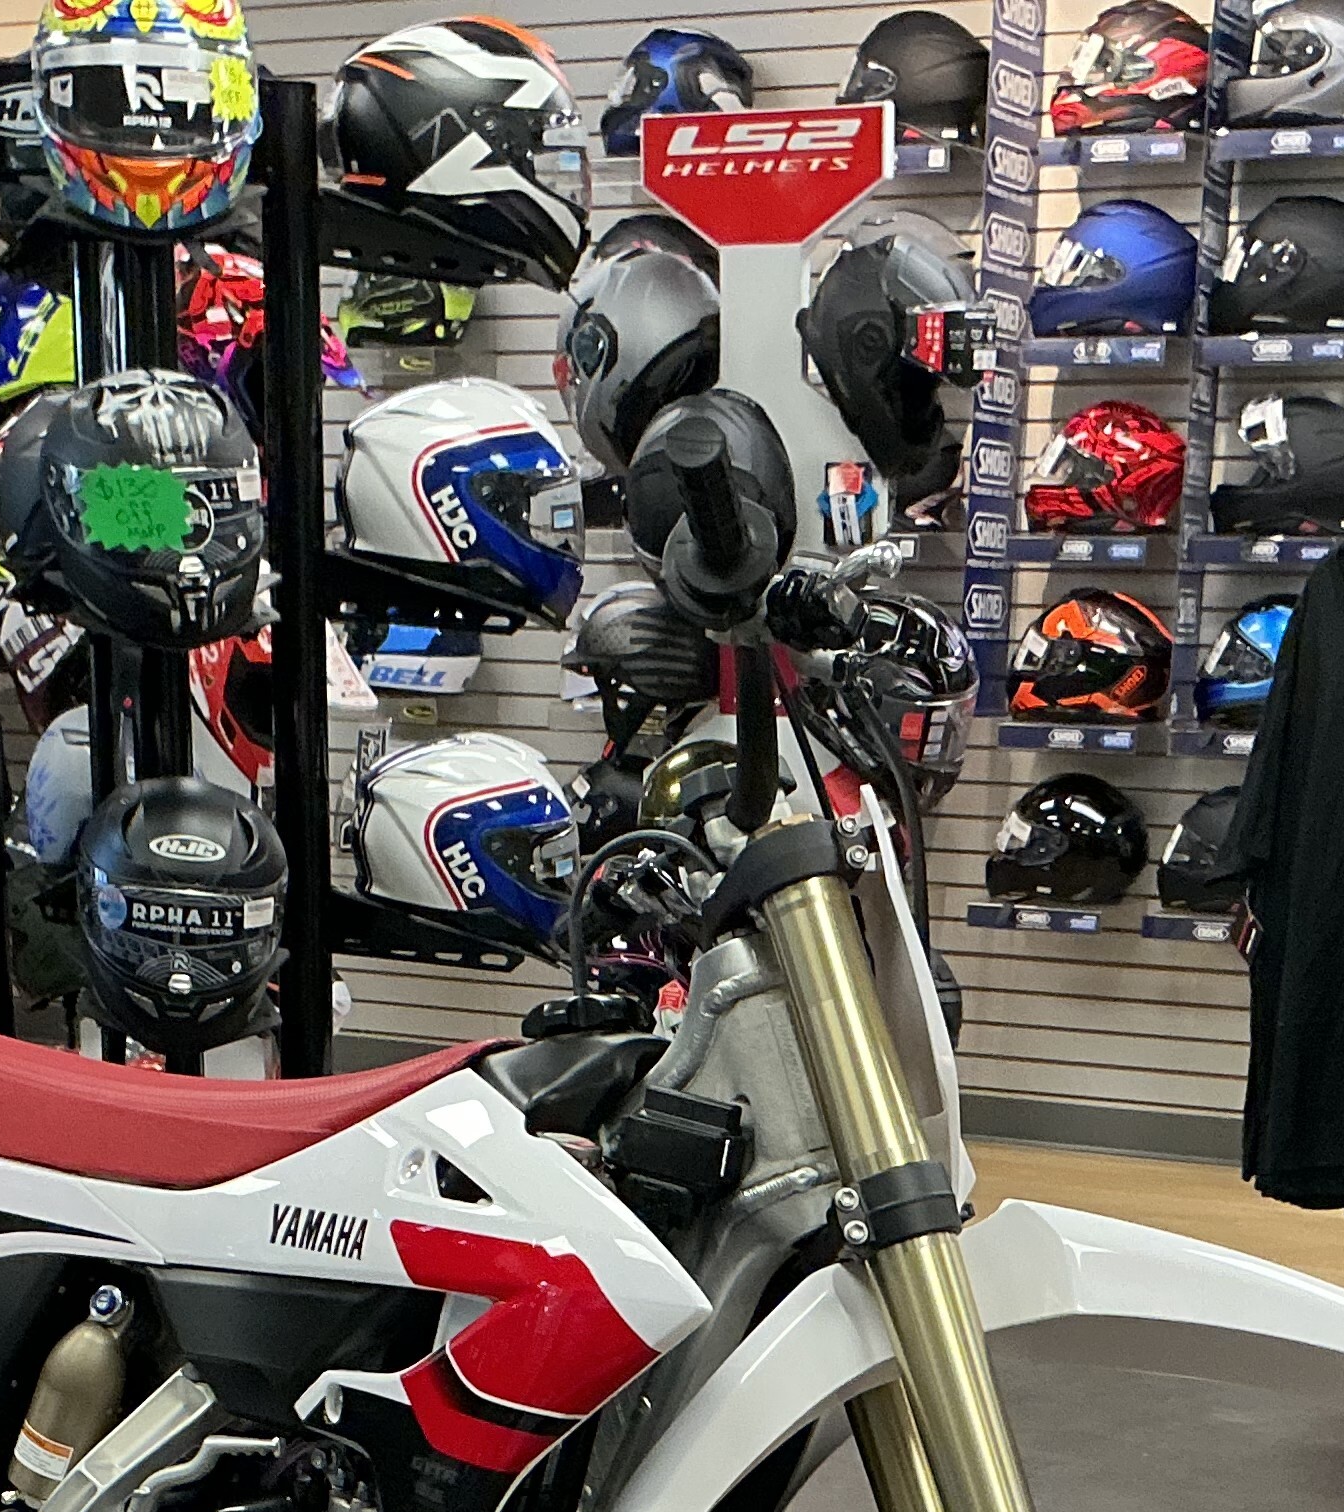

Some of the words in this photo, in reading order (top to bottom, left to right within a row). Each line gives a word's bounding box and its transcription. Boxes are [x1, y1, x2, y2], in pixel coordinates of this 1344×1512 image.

[998, 69, 1033, 107] SHOEI
[666, 118, 862, 156] LS2
[661, 157, 854, 178] HELMETS
[994, 146, 1027, 183] SHOEI
[978, 446, 1011, 477] SHOEI
[431, 484, 477, 549] HJC
[974, 520, 1007, 548] SHOEI
[971, 592, 1003, 619] SHOEI
[369, 664, 447, 686] BELL
[160, 839, 217, 857] HJC
[442, 840, 486, 899] HJC
[132, 902, 202, 926] RPHA
[269, 1203, 369, 1261] YAMAHA
